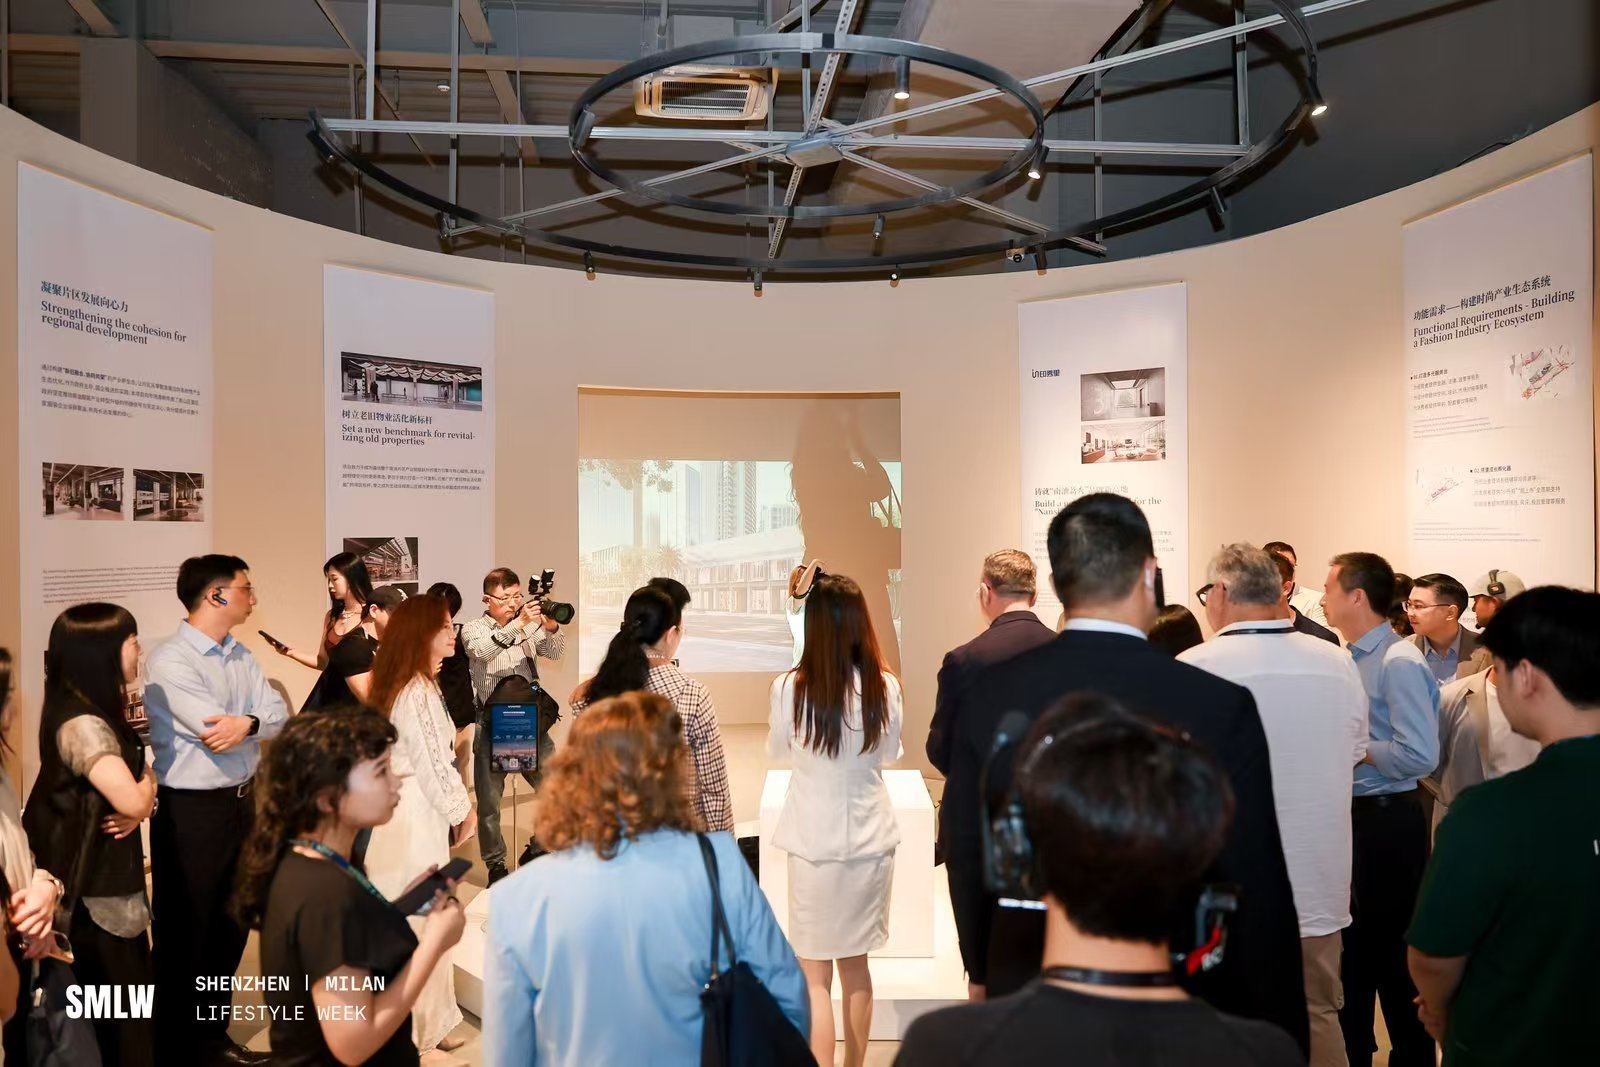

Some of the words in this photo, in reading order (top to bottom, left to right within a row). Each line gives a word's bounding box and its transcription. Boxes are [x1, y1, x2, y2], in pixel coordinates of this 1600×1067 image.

[41, 281, 129, 313] 凝聚片区发展向心力
[41, 300, 113, 328] Strengthening
[115, 318, 131, 330] the
[132, 323, 172, 340] cohesion
[174, 331, 187, 343] for
[1413, 317, 1459, 337] Functional
[1460, 303, 1523, 326] Requirements
[1531, 290, 1575, 308] Building
[1413, 340, 1418, 348] a
[1419, 332, 1453, 347] Fashion
[1455, 323, 1491, 339] Industry
[1494, 310, 1545, 329] Ecosystem
[41, 314, 84, 331] regional
[85, 323, 148, 345] development
[341, 424, 356, 433] Set
[365, 426, 382, 434] new
[384, 427, 432, 438] benchmark
[434, 430, 446, 438] for
[447, 431, 476, 440] revital-
[342, 409, 433, 425] 树立老旧物业活化新标杆
[342, 432, 364, 444] izing
[365, 434, 379, 443] old
[381, 436, 425, 446] properties
[1035, 499, 1055, 507] Build
[1148, 497, 1162, 505] the
